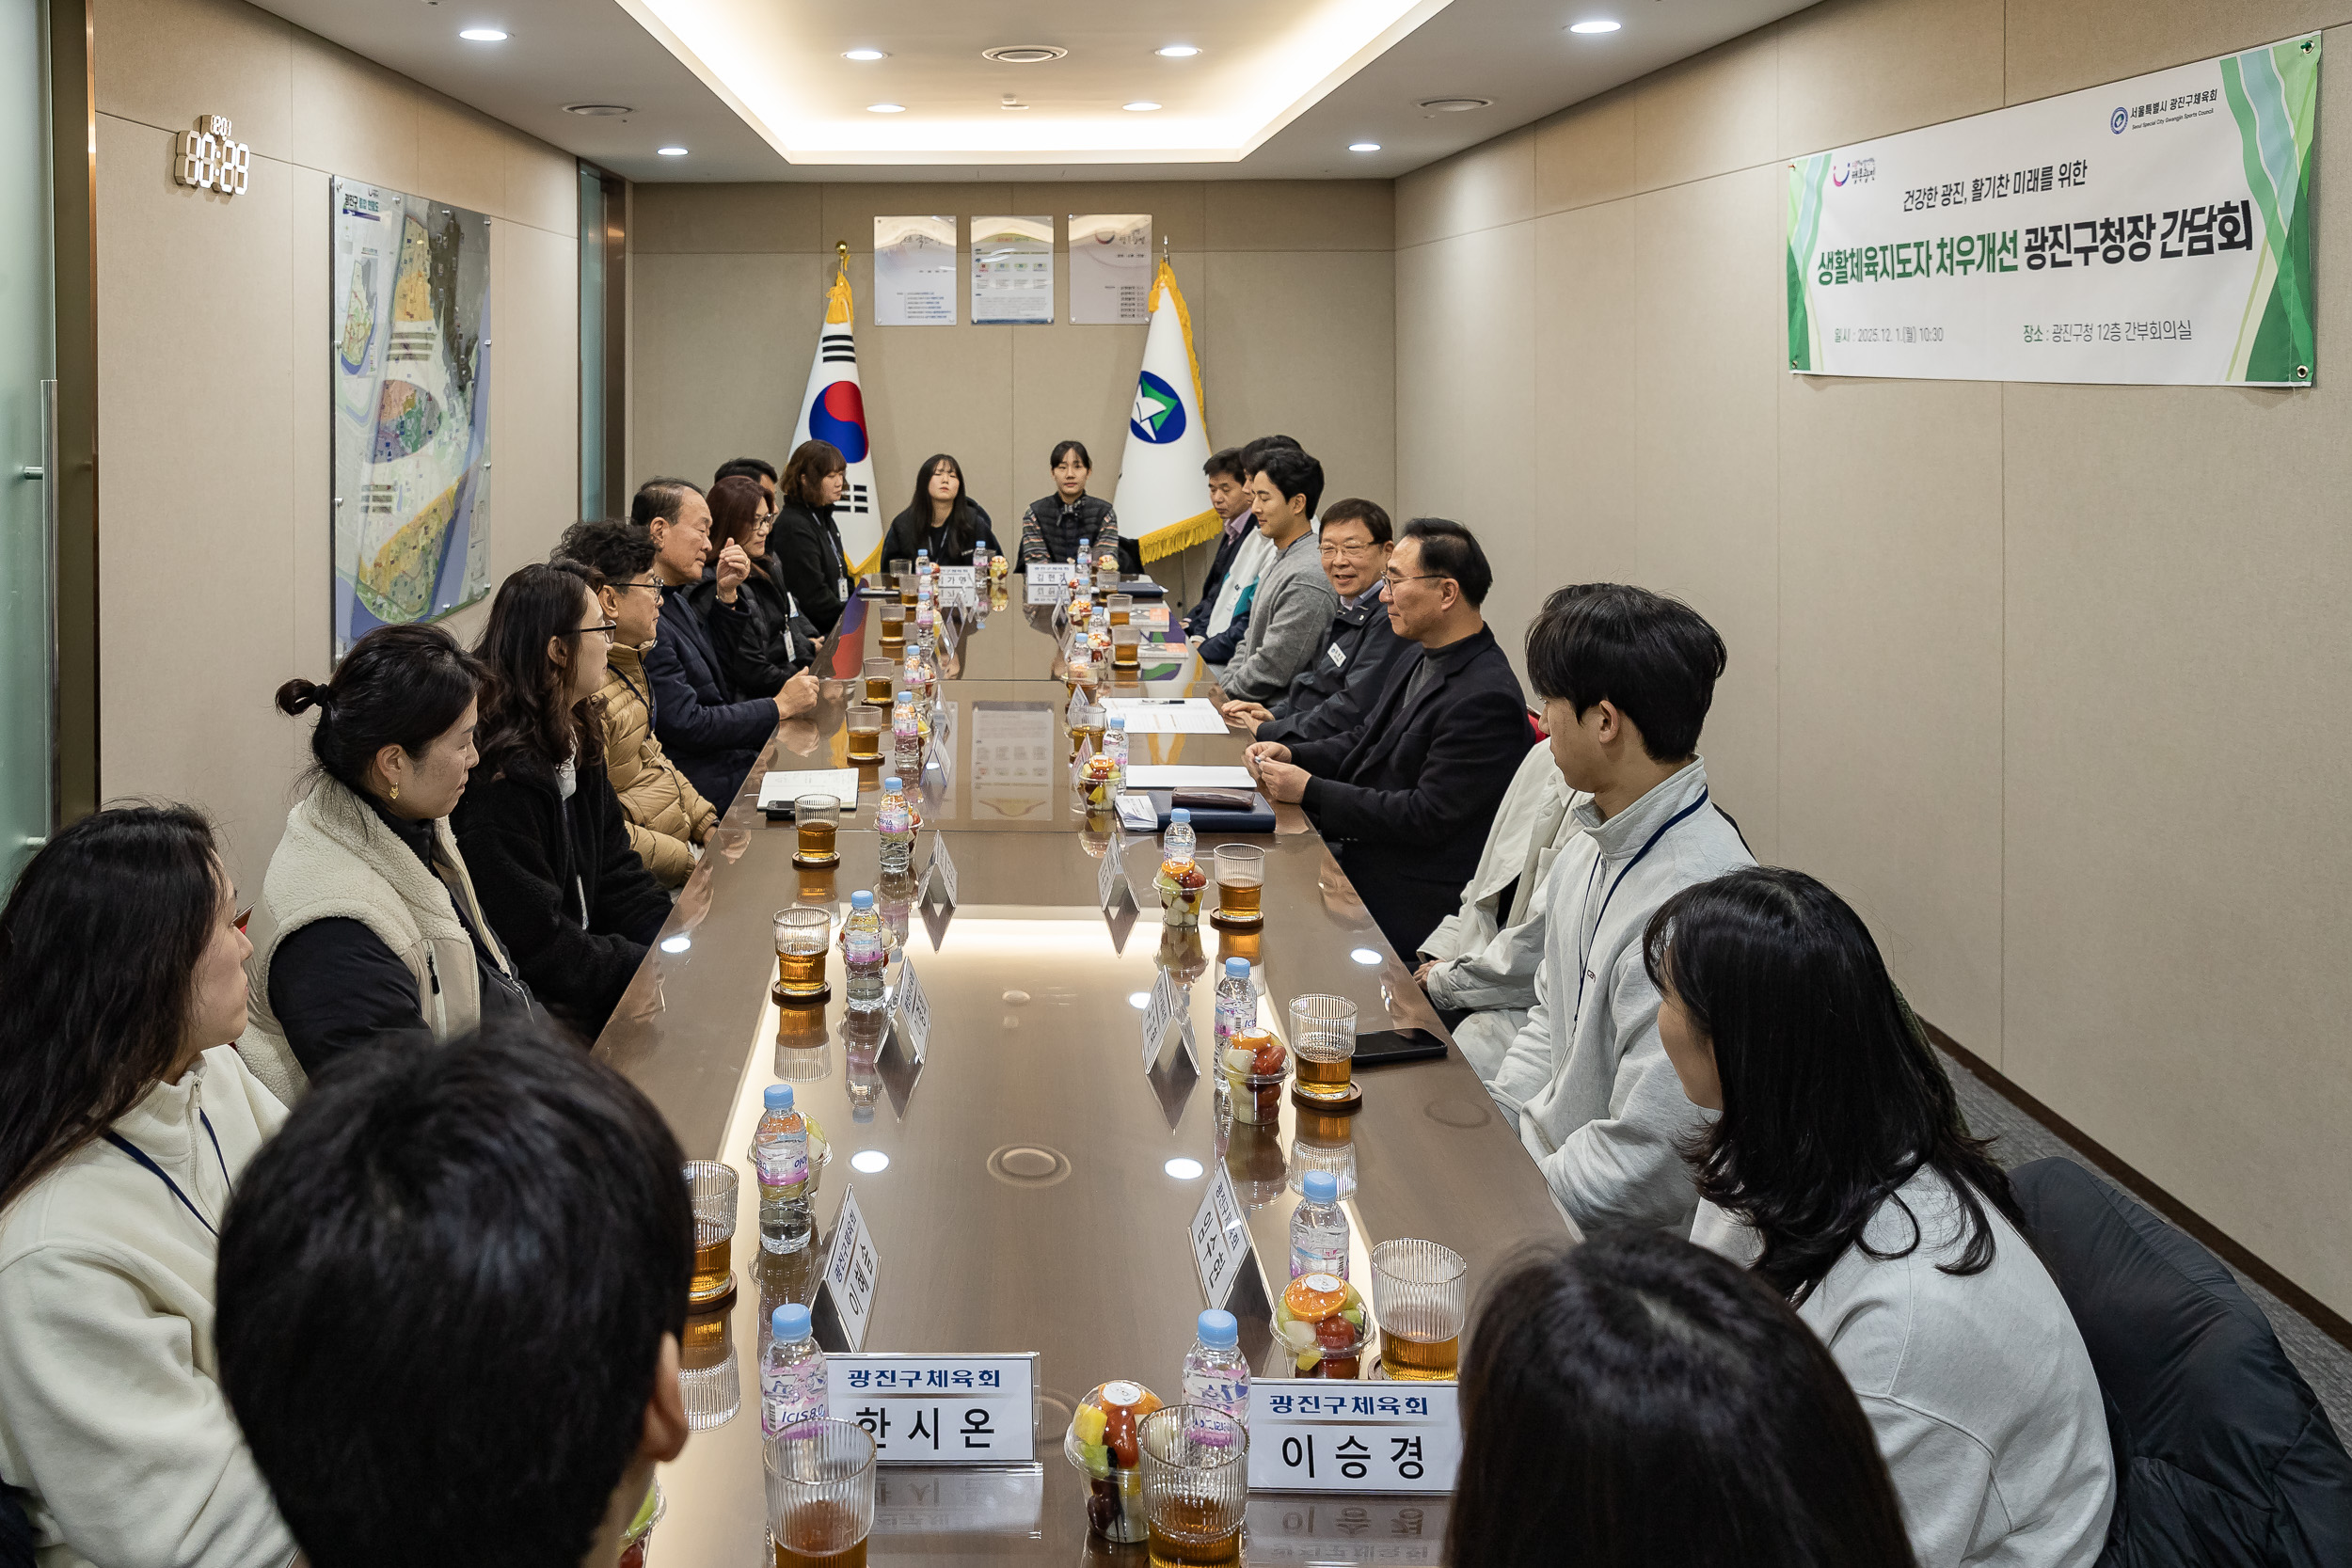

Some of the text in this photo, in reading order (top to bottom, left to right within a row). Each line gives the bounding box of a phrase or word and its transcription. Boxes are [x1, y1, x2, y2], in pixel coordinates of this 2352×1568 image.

[2130, 88, 2218, 119] 서울특별시 광진구체육회
[1903, 159, 2088, 213] 건강한 광진, 활기찬 미래를 위한
[1818, 199, 2253, 286] 생활체육지도자 처우개선 광진구청장 간담회
[1835, 327, 1851, 343] 일시
[1919, 326, 1945, 342] 10:30
[2023, 325, 2043, 343] 장소
[2052, 323, 2094, 343] 광진구청
[2097, 323, 2122, 342] 12층
[2124, 320, 2192, 341] 간부회의실
[834, 1209, 857, 1284] 광진구체육회
[1197, 1211, 1226, 1290] 임수현
[848, 1370, 1000, 1388] 광진구체육회
[1269, 1394, 1428, 1416] 광진구체육회
[1281, 1433, 1424, 1480] 이승경
